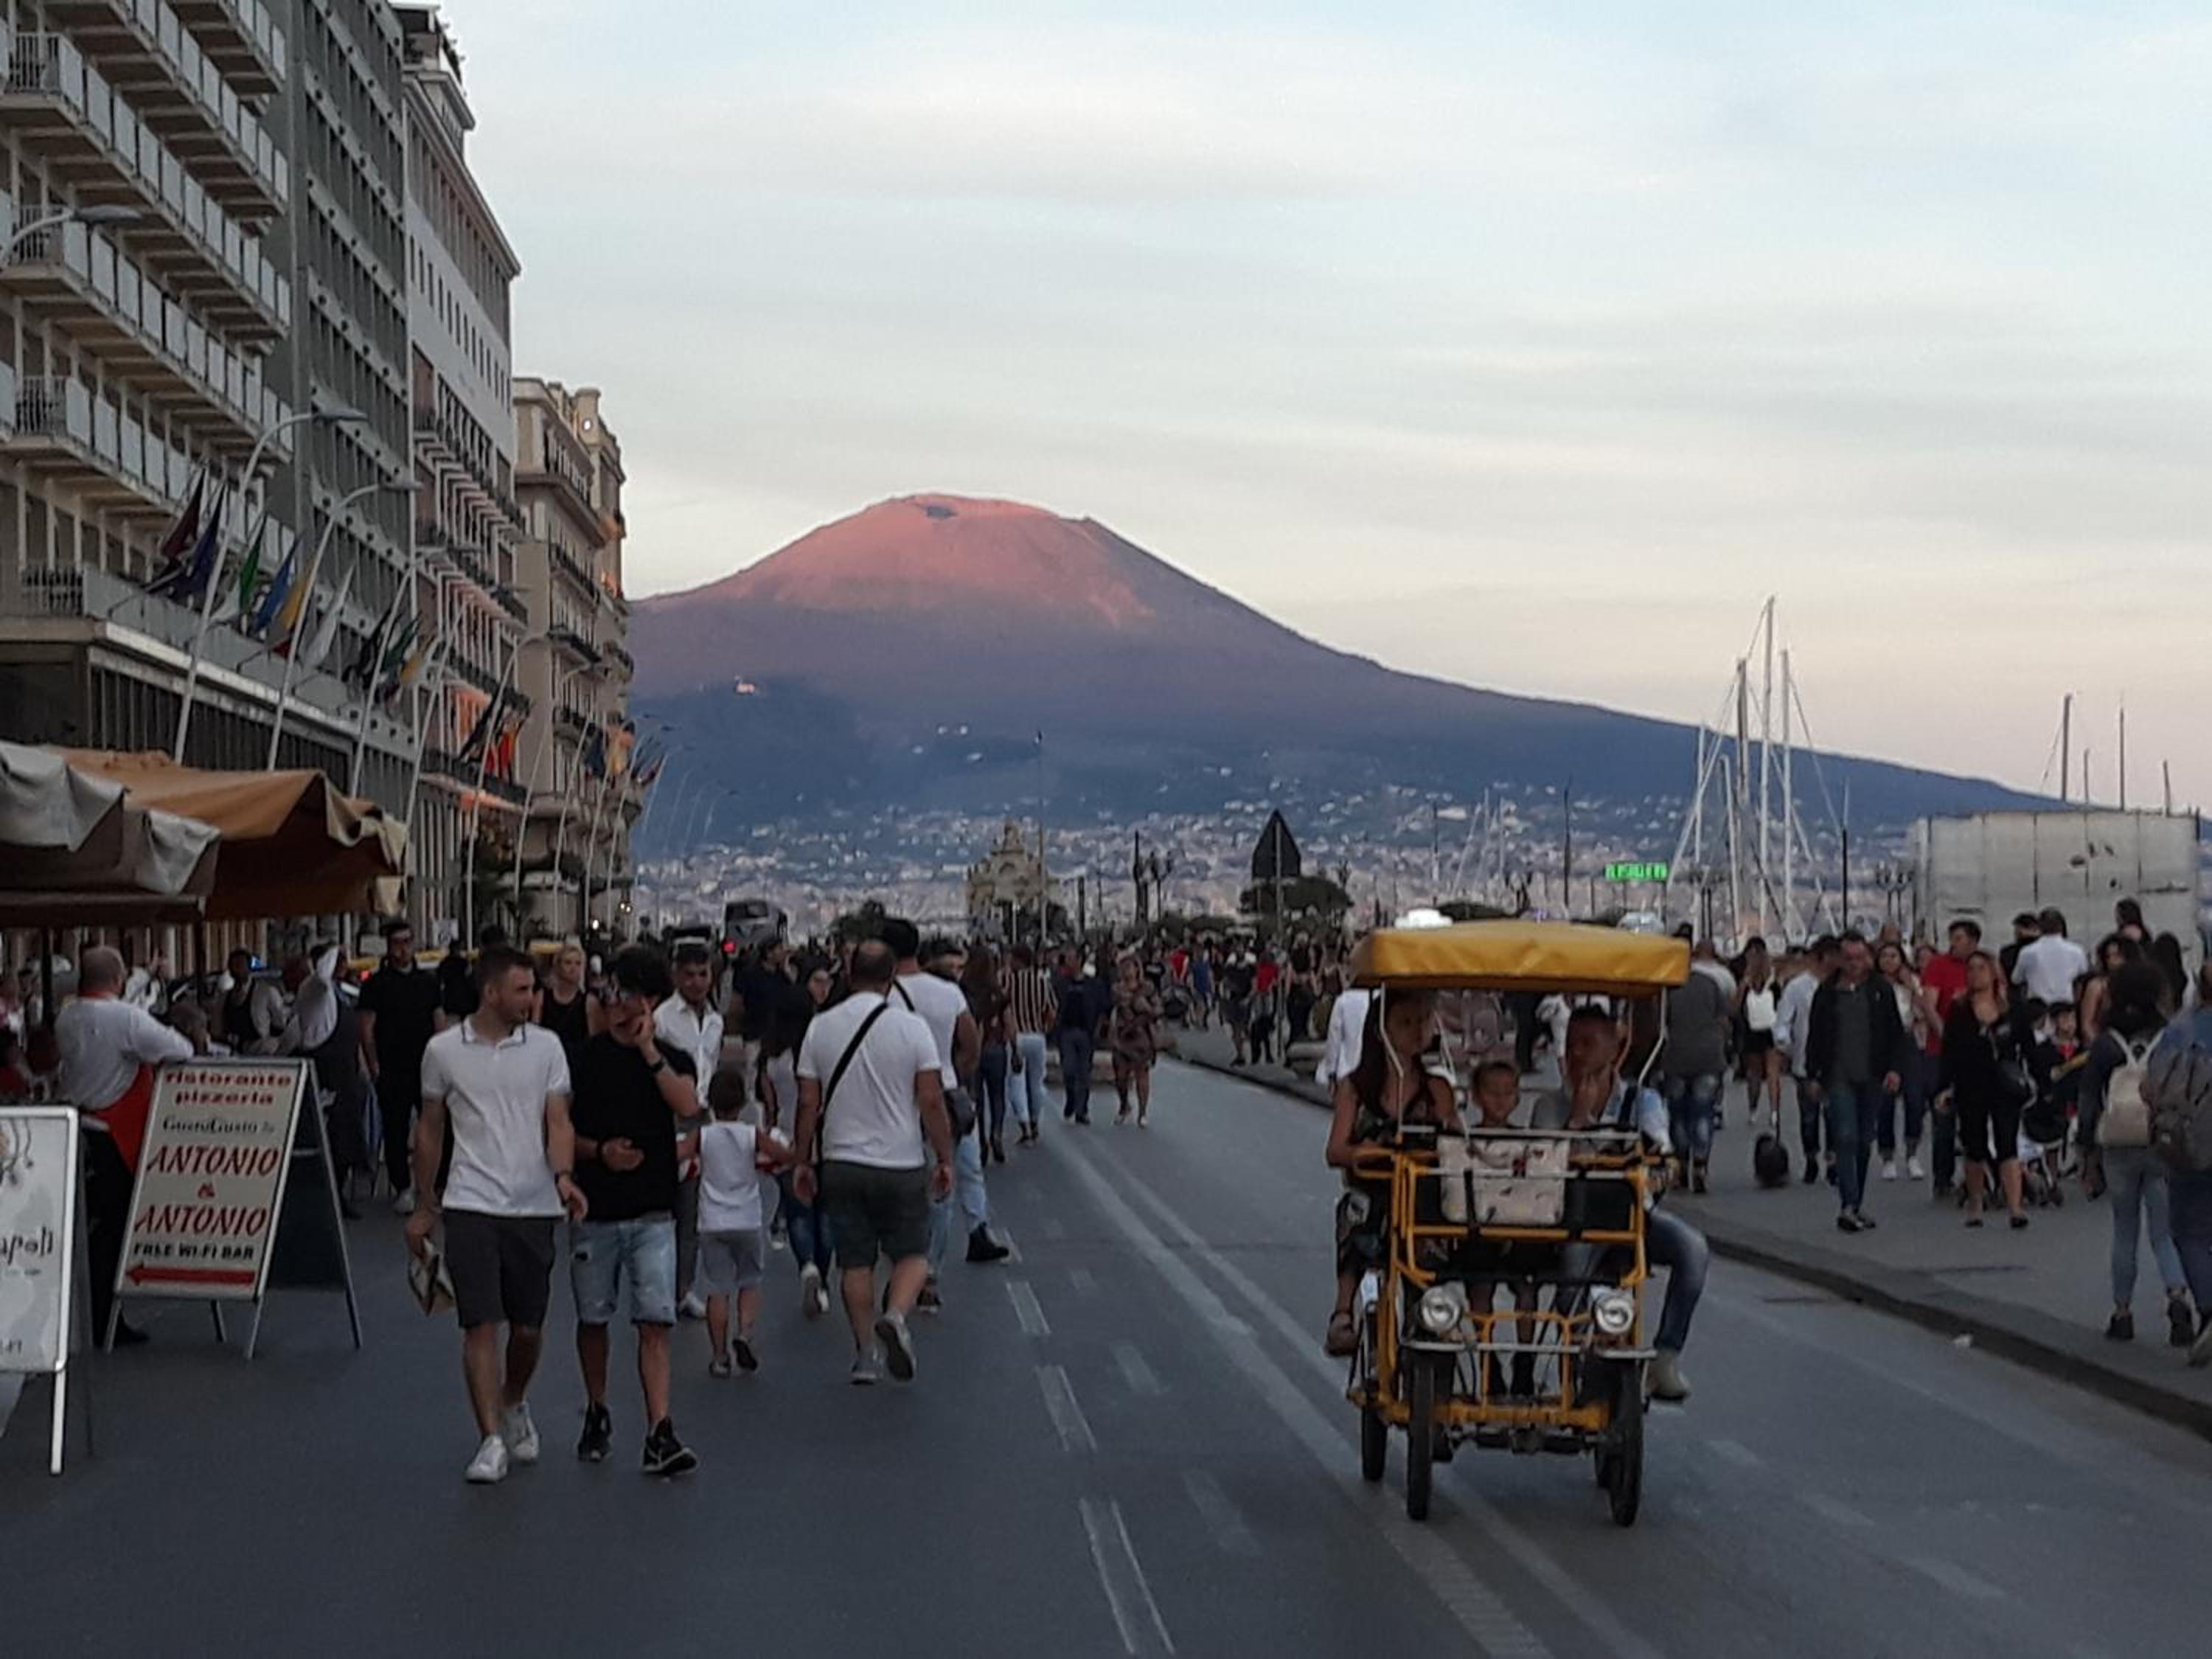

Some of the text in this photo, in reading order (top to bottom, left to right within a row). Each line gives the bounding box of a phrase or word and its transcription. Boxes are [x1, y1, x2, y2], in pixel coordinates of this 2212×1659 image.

[166, 1071, 291, 1086] ristorante
[175, 1088, 274, 1105] pizzeria
[147, 1145, 279, 1176] ANTONIO
[134, 1205, 267, 1236] ANTONIO
[133, 1243, 173, 1257] FREE
[222, 1245, 254, 1260] BAR
